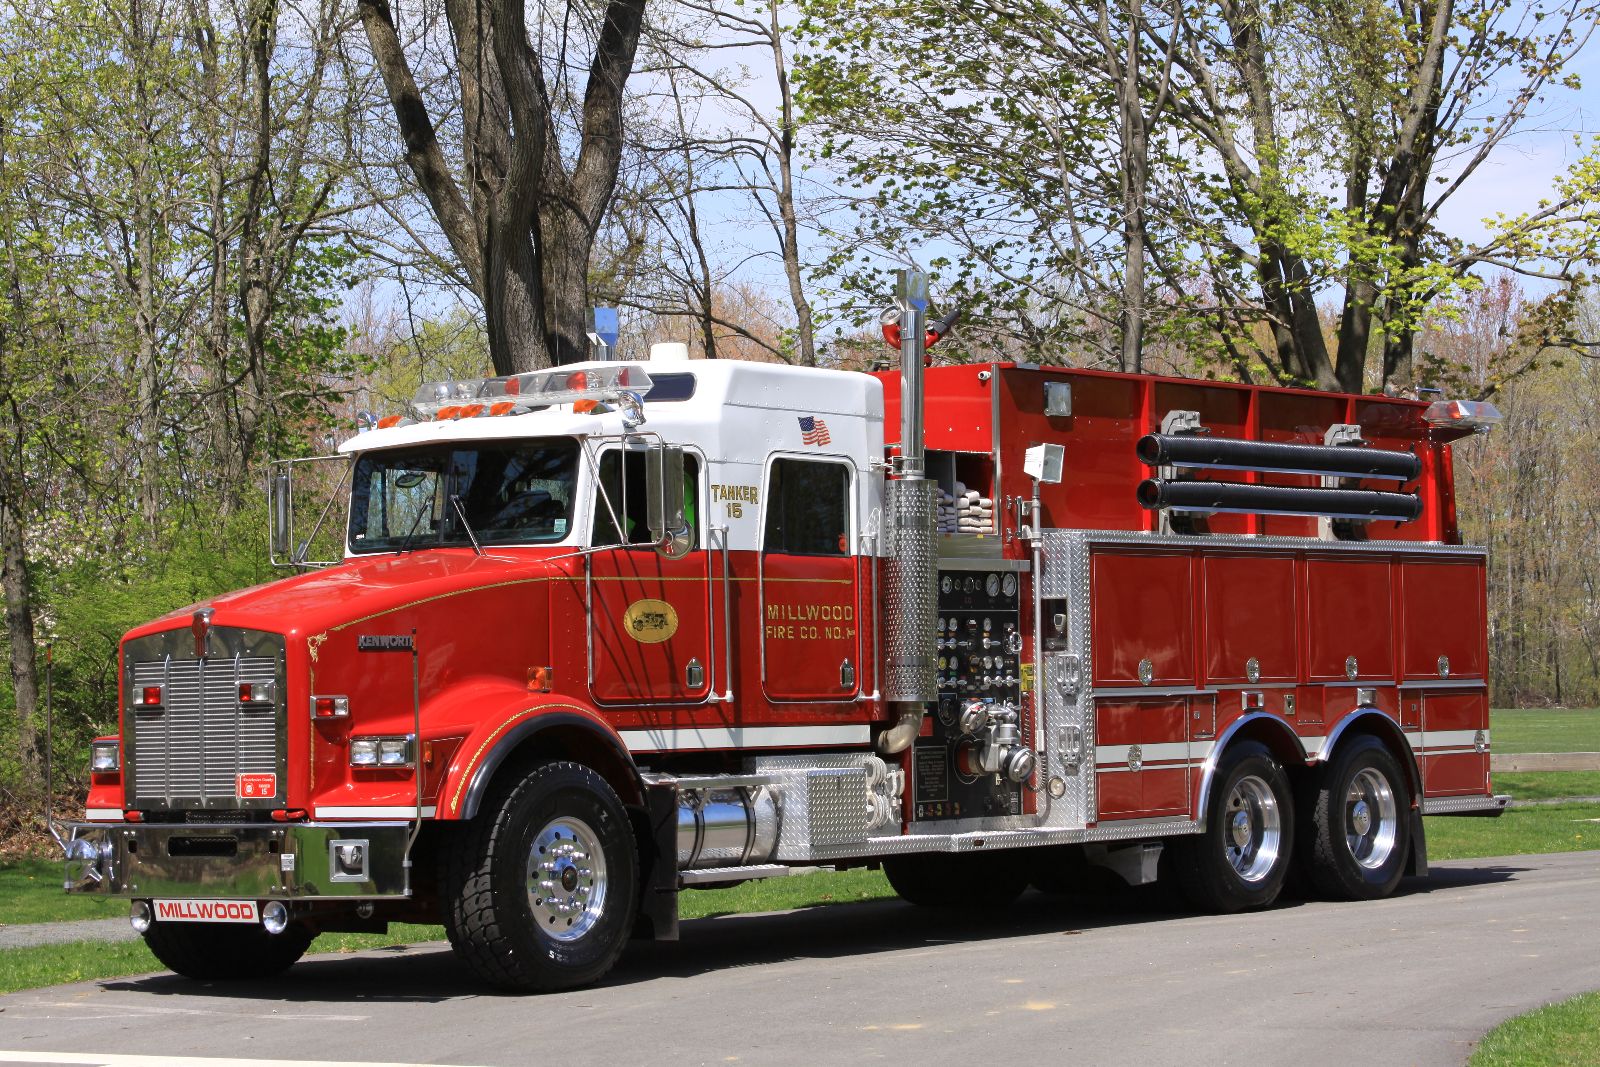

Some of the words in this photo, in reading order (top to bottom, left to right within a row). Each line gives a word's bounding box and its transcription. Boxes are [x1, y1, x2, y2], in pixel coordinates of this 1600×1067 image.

[711, 485, 758, 504] TANKER
[726, 503, 742, 518] 15
[768, 605, 853, 620] MILLWOOD
[766, 626, 794, 639] FIRE
[800, 626, 821, 639] CO.
[159, 903, 253, 919] MILLWOOD
